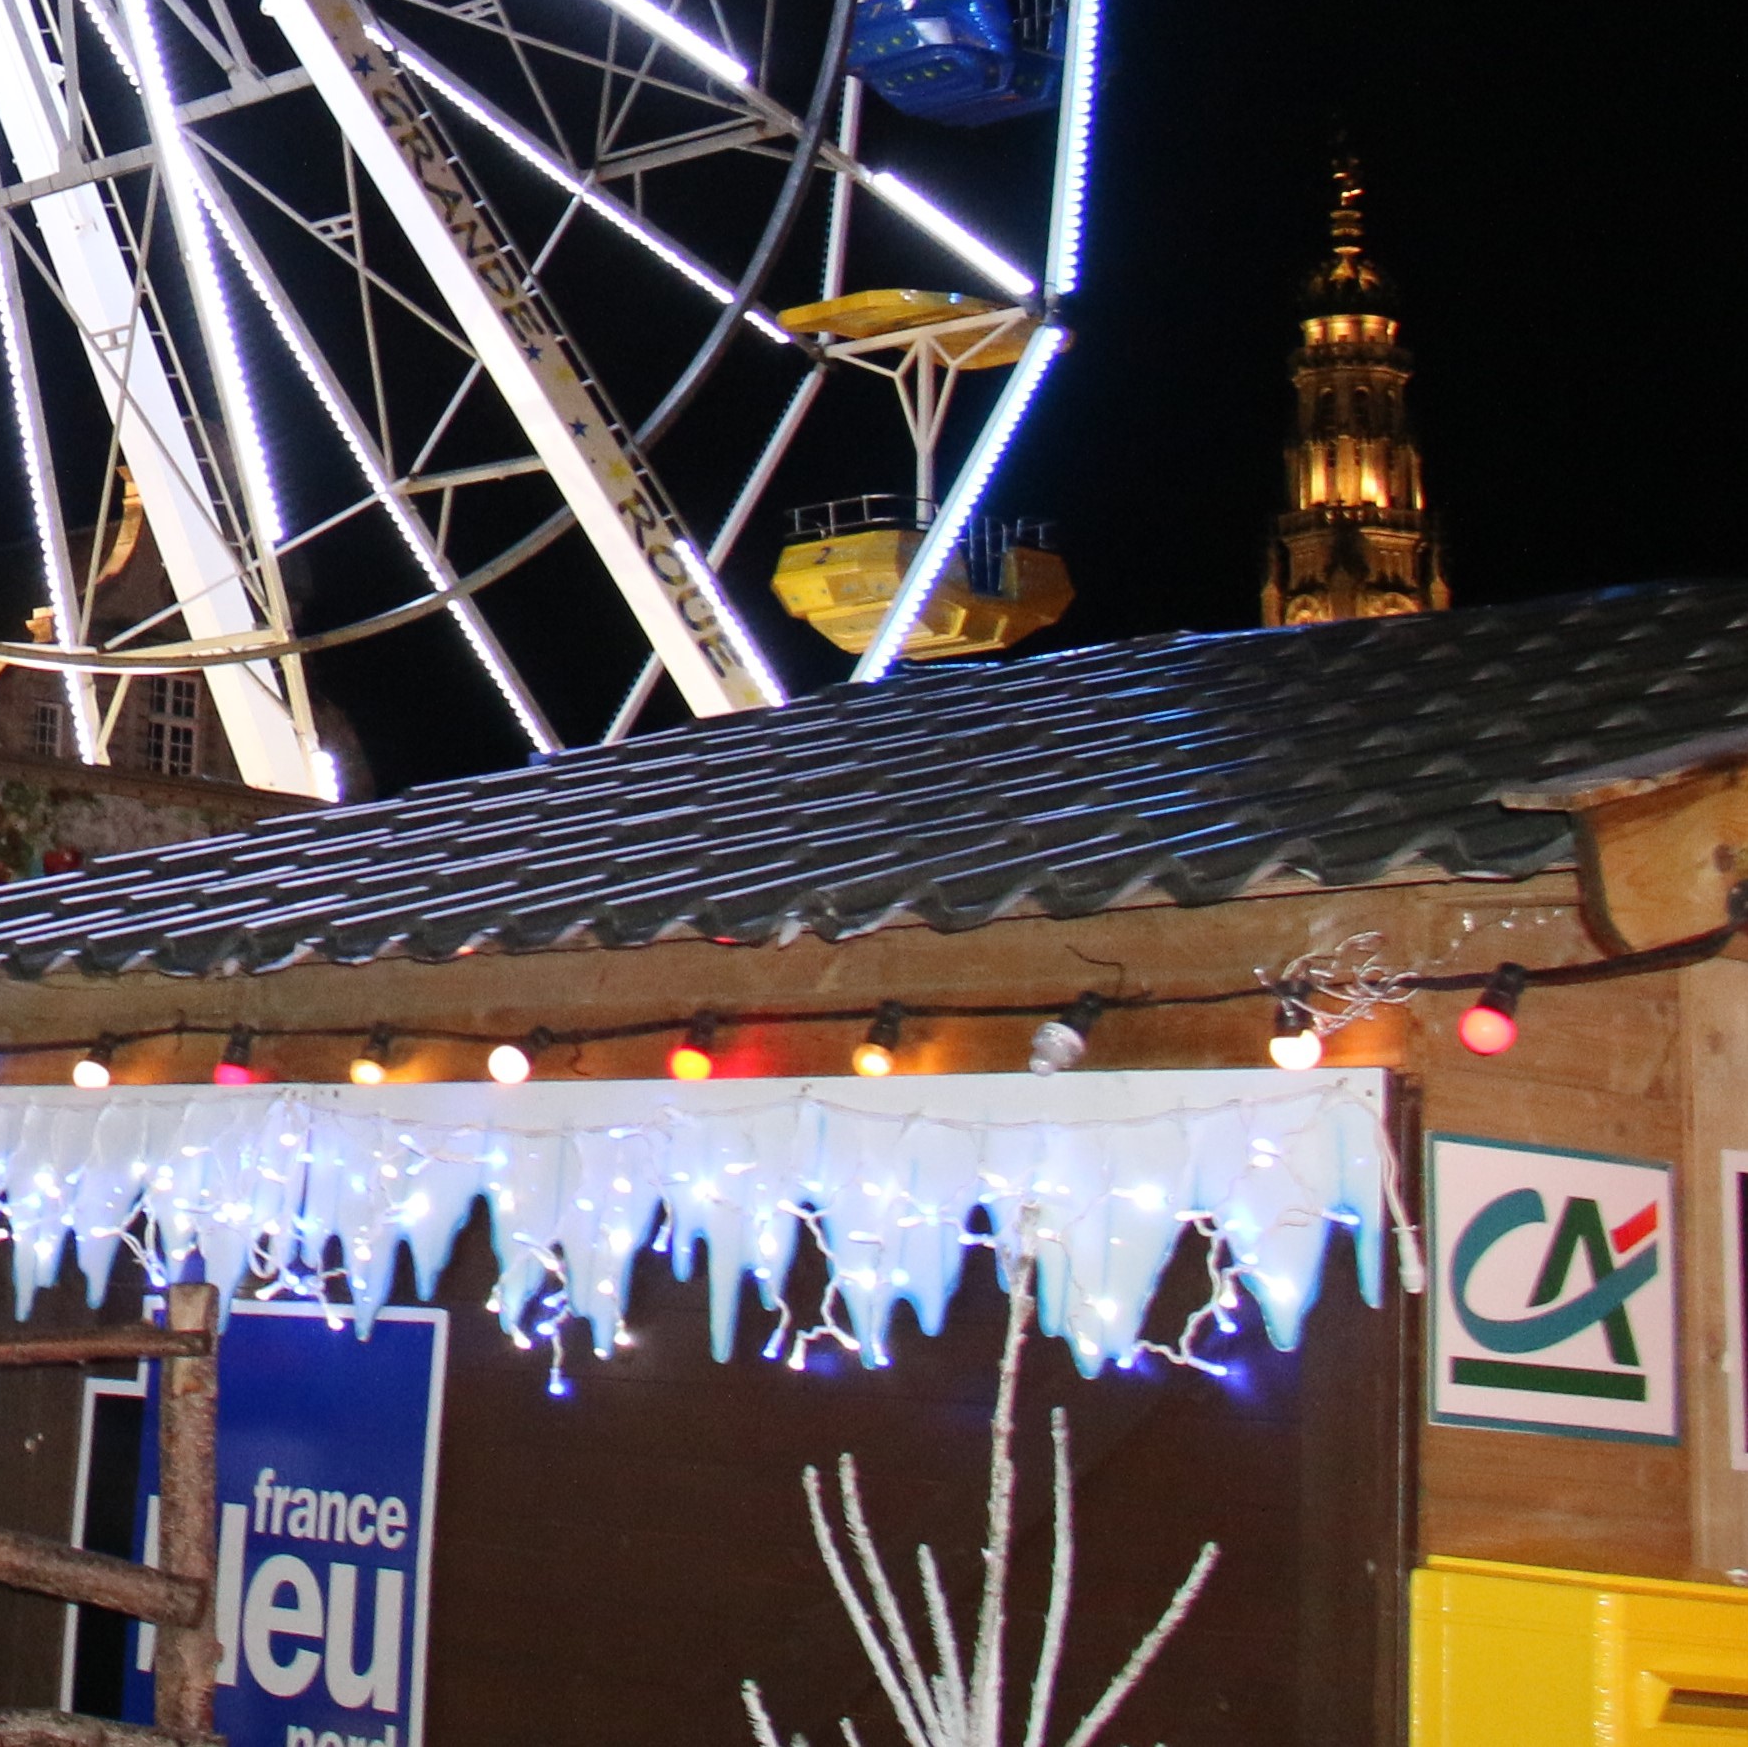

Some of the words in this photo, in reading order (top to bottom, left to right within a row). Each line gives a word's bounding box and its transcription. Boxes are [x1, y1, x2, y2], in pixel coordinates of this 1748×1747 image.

[372, 89, 547, 343] GRANDE
[618, 488, 744, 678] ROUE
[1449, 1187, 1659, 1368] CA
[253, 1466, 409, 1550] france
